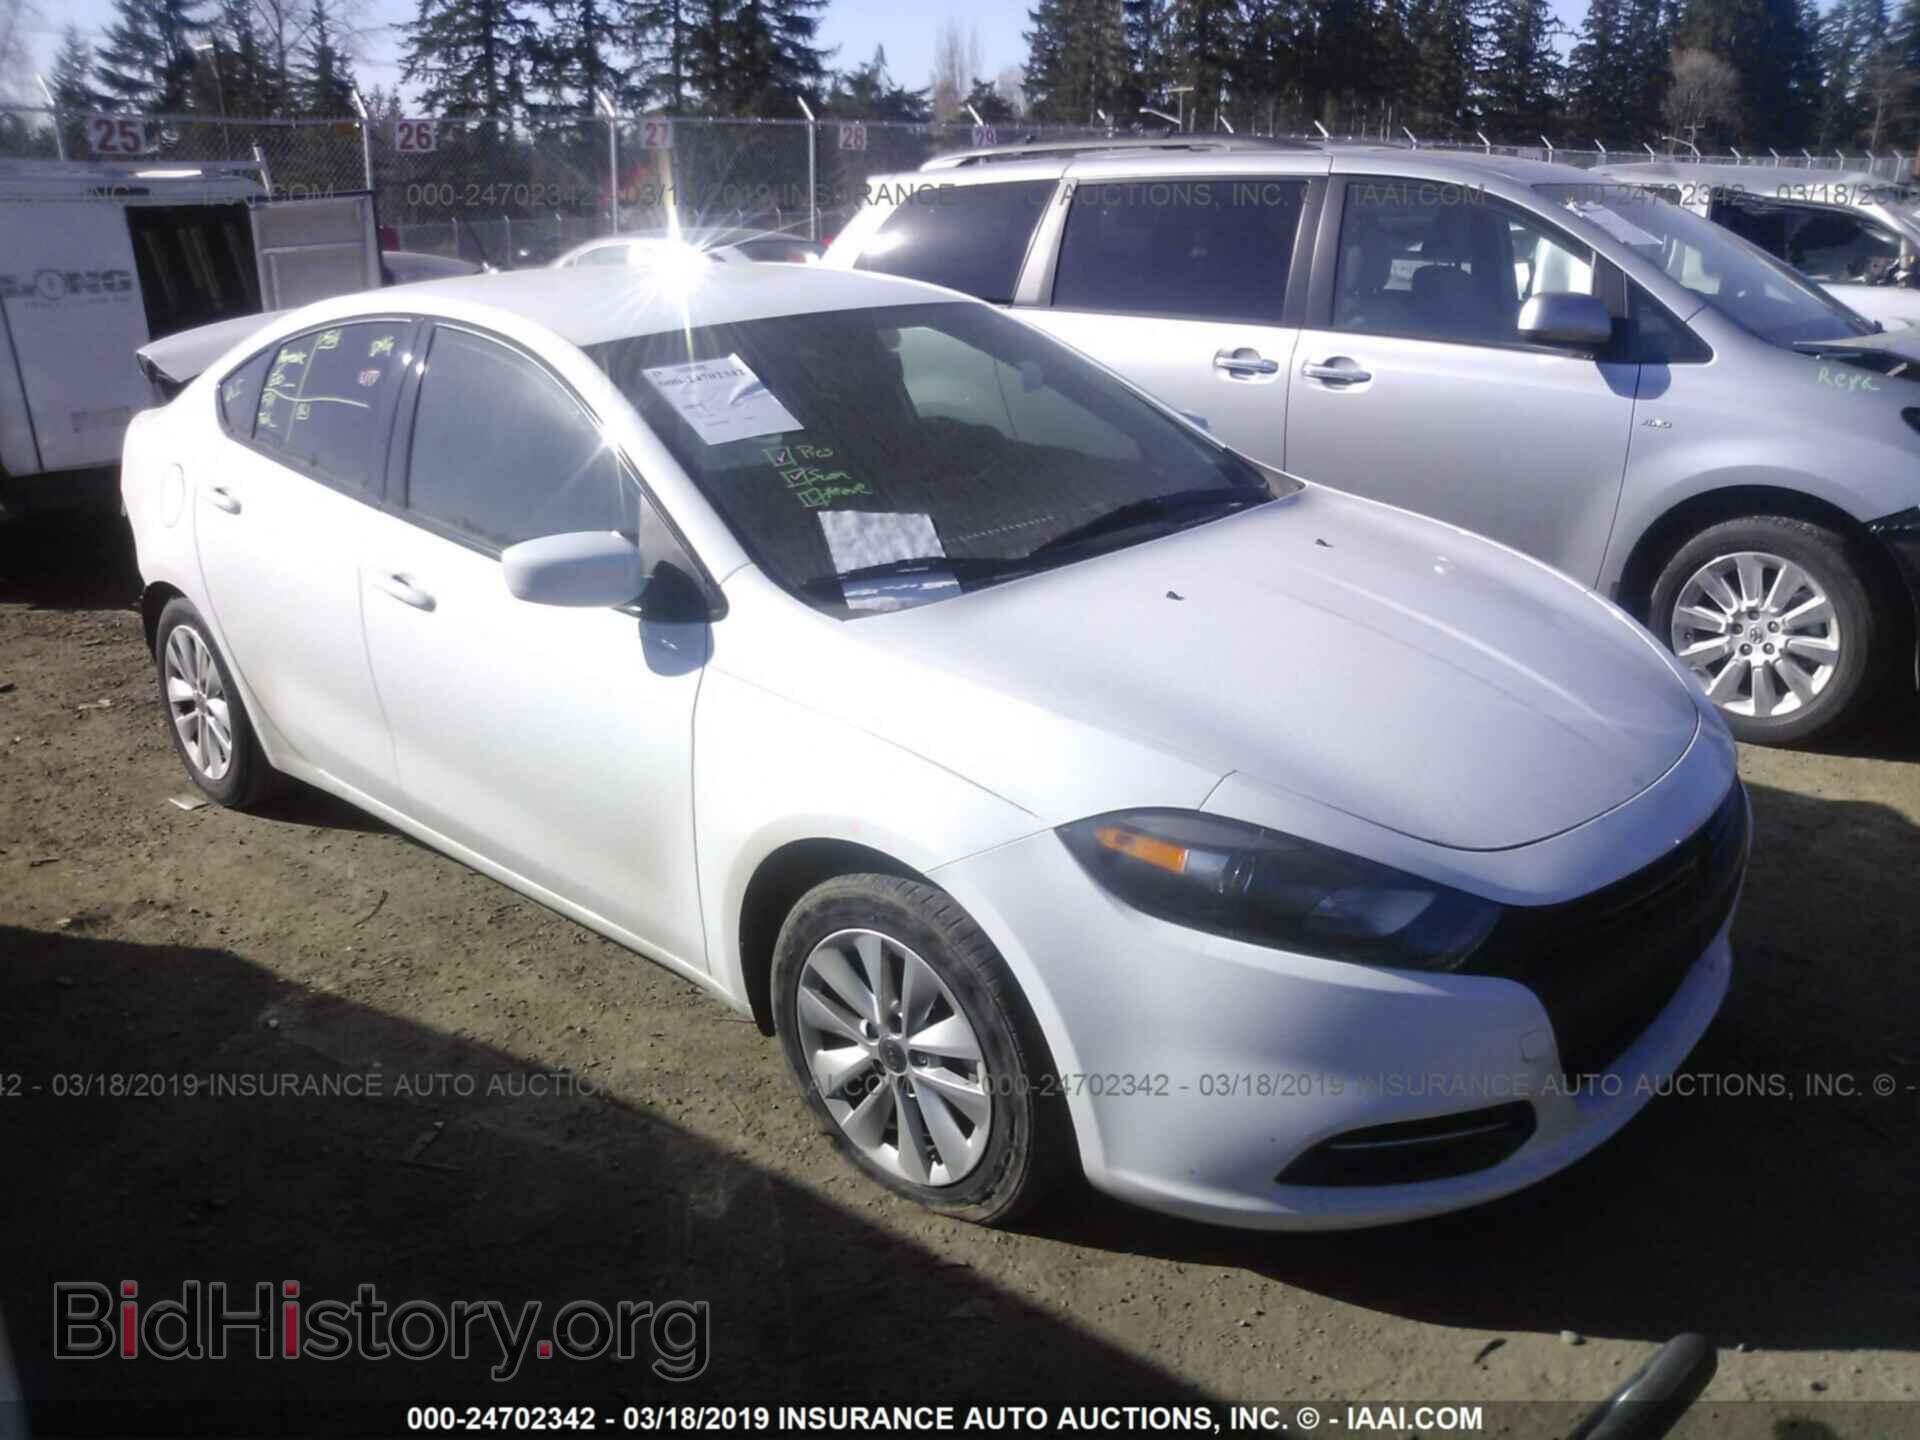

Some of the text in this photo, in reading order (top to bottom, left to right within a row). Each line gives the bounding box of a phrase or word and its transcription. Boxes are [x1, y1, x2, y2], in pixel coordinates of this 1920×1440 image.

[94, 119, 142, 151] 25
[399, 122, 433, 149] 26
[645, 122, 669, 148] 27
[842, 125, 865, 149] 28
[975, 124, 996, 146] 29
